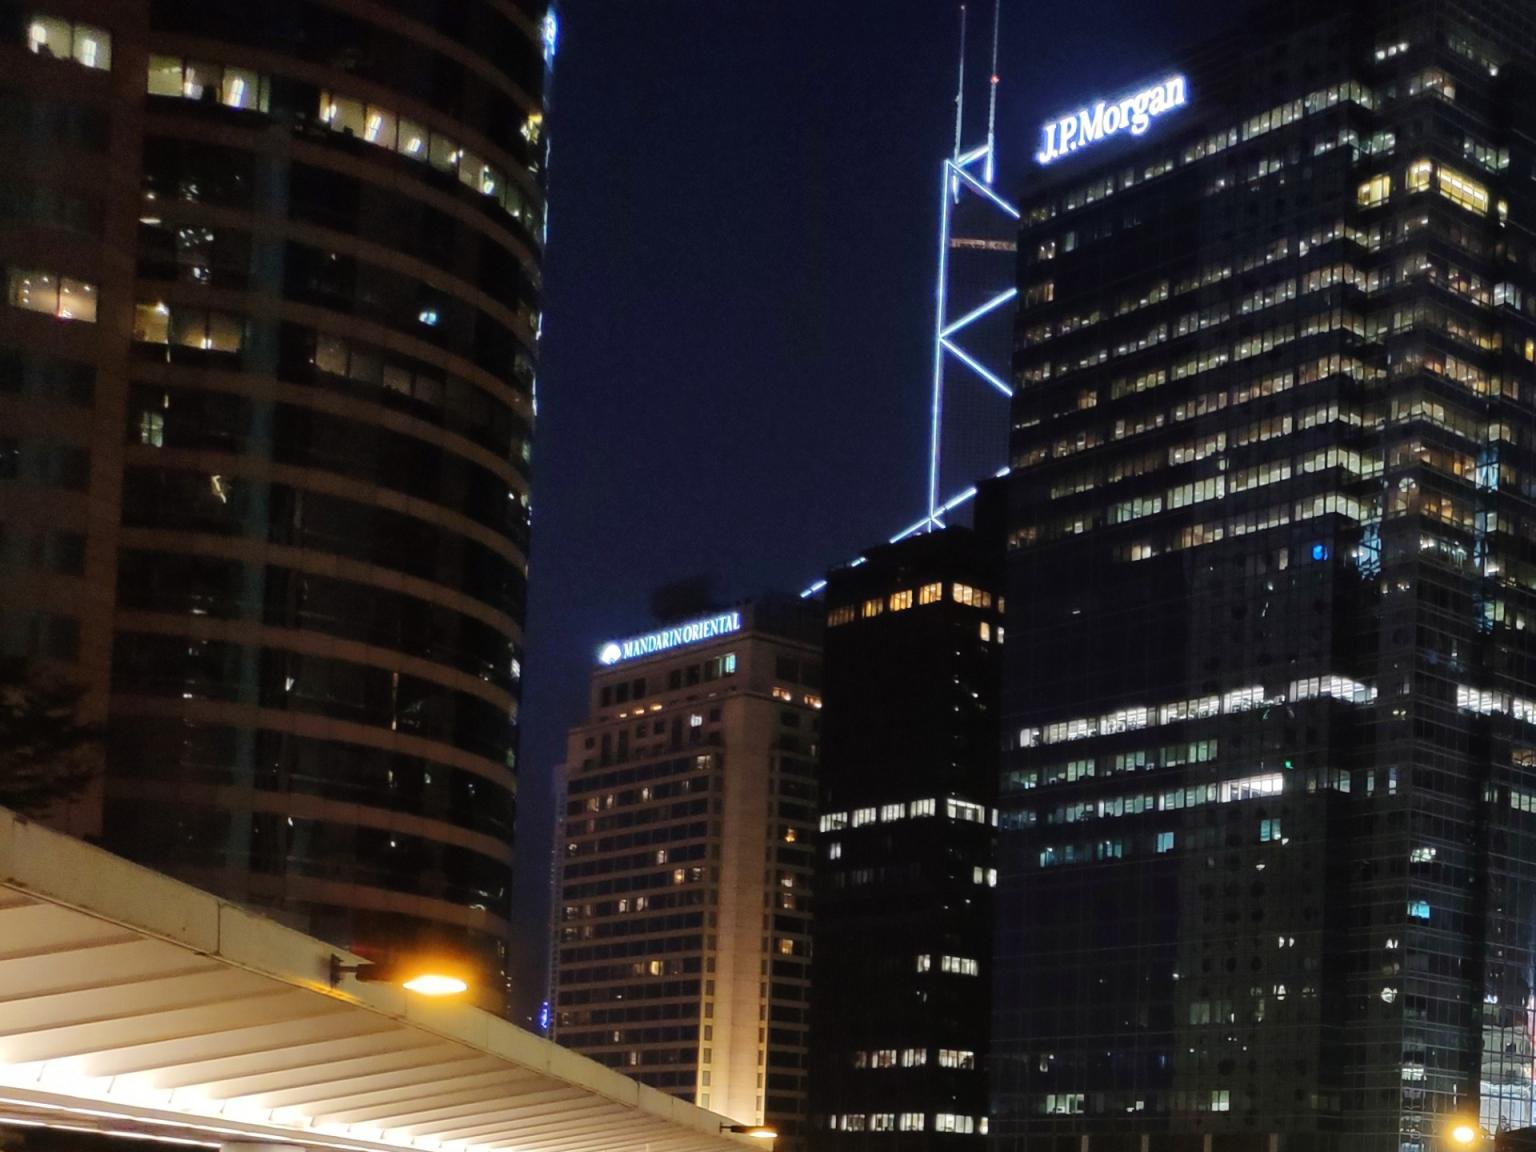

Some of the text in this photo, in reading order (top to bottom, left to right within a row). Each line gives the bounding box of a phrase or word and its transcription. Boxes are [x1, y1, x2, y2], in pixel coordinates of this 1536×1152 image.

[1038, 75, 1186, 164] J.P.Morgan
[622, 612, 741, 659] MANDARIN ORIENTAL
